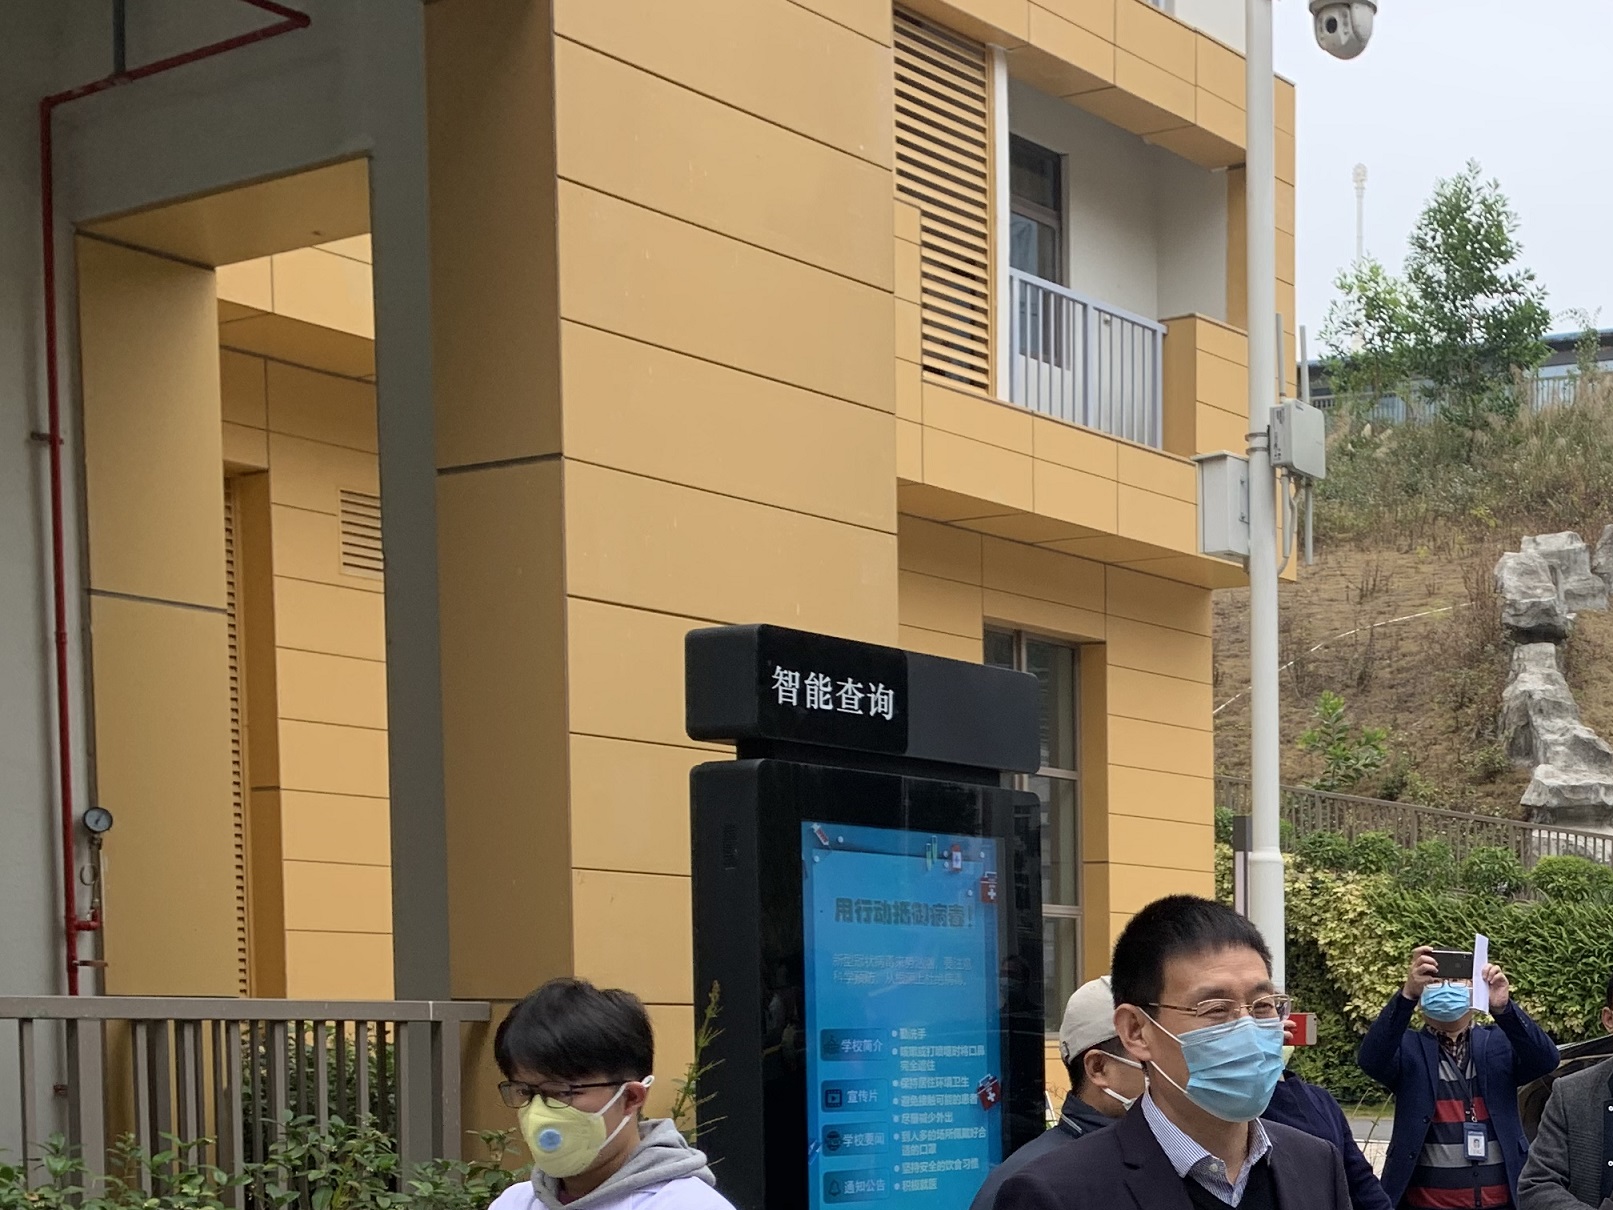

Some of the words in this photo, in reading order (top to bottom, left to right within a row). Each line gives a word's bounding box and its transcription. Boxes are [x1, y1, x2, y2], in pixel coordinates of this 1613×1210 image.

[771, 664, 895, 720] 智能查询
[841, 1039, 884, 1053] 学校简介
[847, 1090, 879, 1104] 宣传片
[844, 1179, 886, 1194] 通知公告
